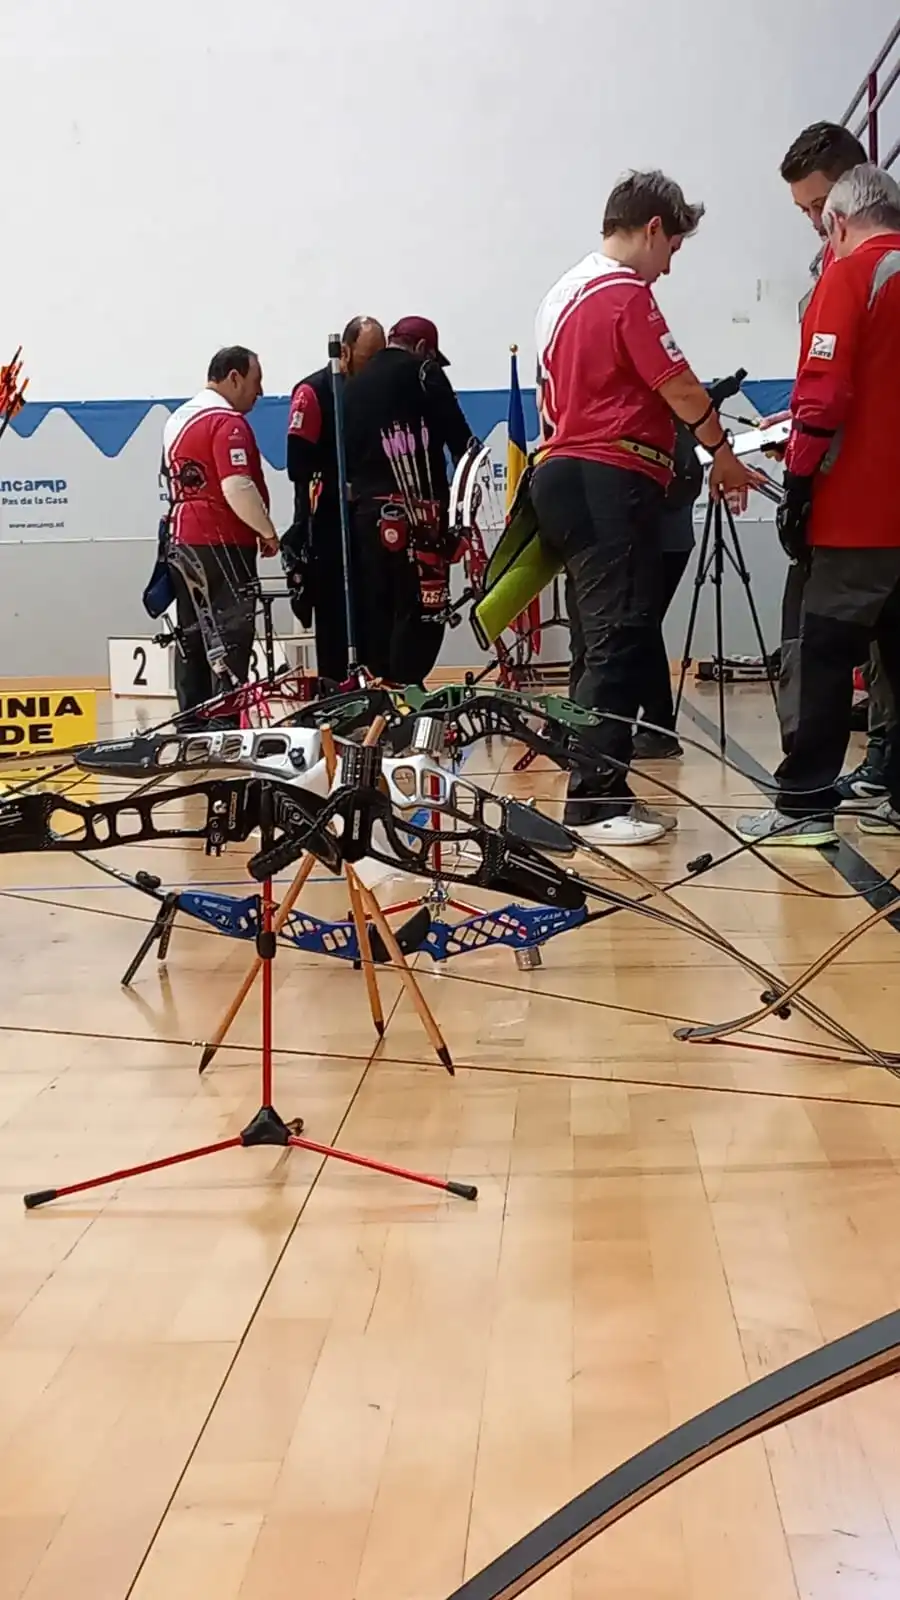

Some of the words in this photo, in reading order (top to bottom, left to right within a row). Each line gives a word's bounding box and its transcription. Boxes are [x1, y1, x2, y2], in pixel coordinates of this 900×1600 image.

[0, 479, 67, 493] ncamp
[2, 497, 18, 505] Pas
[20, 496, 33, 505] de
[45, 496, 68, 505] Casa
[133, 646, 147, 686] 2
[0, 696, 83, 718] NIA
[0, 723, 54, 745] DE
